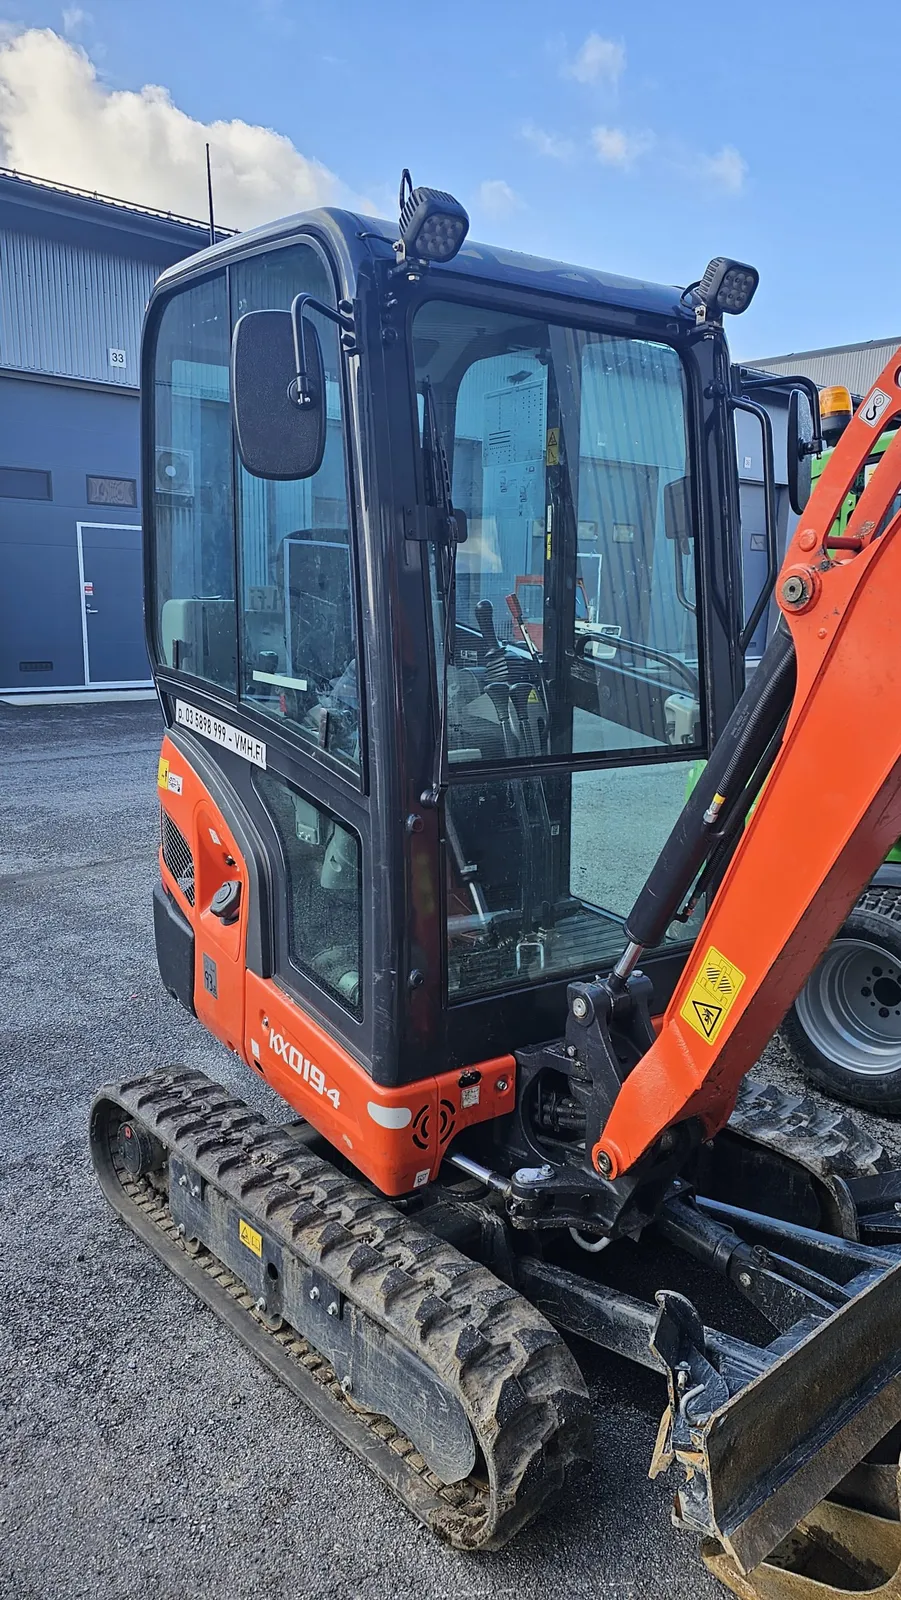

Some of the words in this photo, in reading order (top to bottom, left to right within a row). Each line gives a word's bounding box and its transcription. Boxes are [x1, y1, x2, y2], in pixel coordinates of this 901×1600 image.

[112, 352, 124, 363] 33
[178, 708, 184, 723] p.
[185, 707, 193, 724] 03
[195, 712, 212, 734] 5898
[213, 722, 227, 742] 999
[234, 732, 264, 763] VMH.FI
[204, 971, 213, 992] 93
